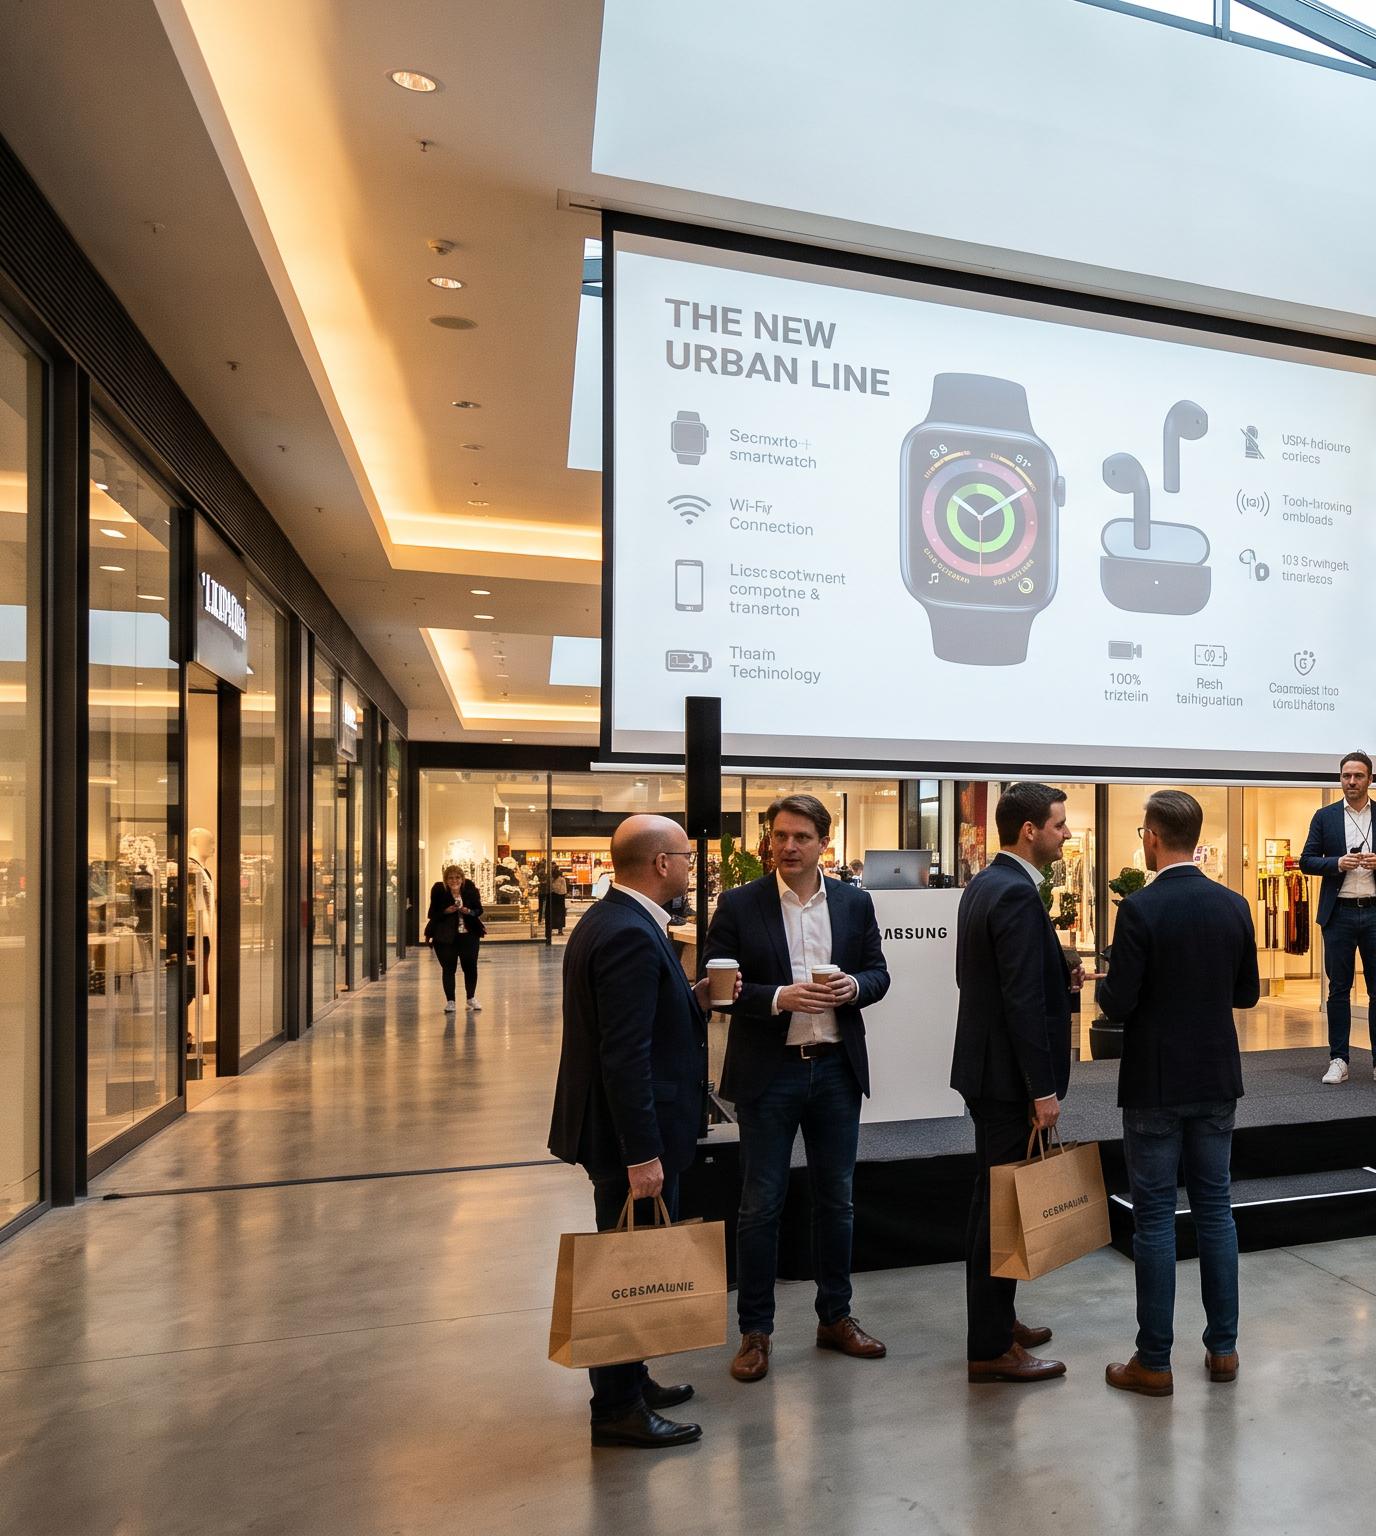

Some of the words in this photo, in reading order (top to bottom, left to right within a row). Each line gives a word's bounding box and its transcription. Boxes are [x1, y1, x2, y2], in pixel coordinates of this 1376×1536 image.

[664, 297, 743, 337] THE
[754, 311, 837, 349] NEW
[665, 339, 798, 385] URBAN
[811, 359, 890, 397] LINE
[729, 450, 817, 469] smartwatch
[729, 516, 814, 536] Connection
[729, 584, 806, 600] compotne
[810, 588, 820, 600] &
[729, 664, 821, 685] Techinology
[1109, 672, 1142, 686] 100%
